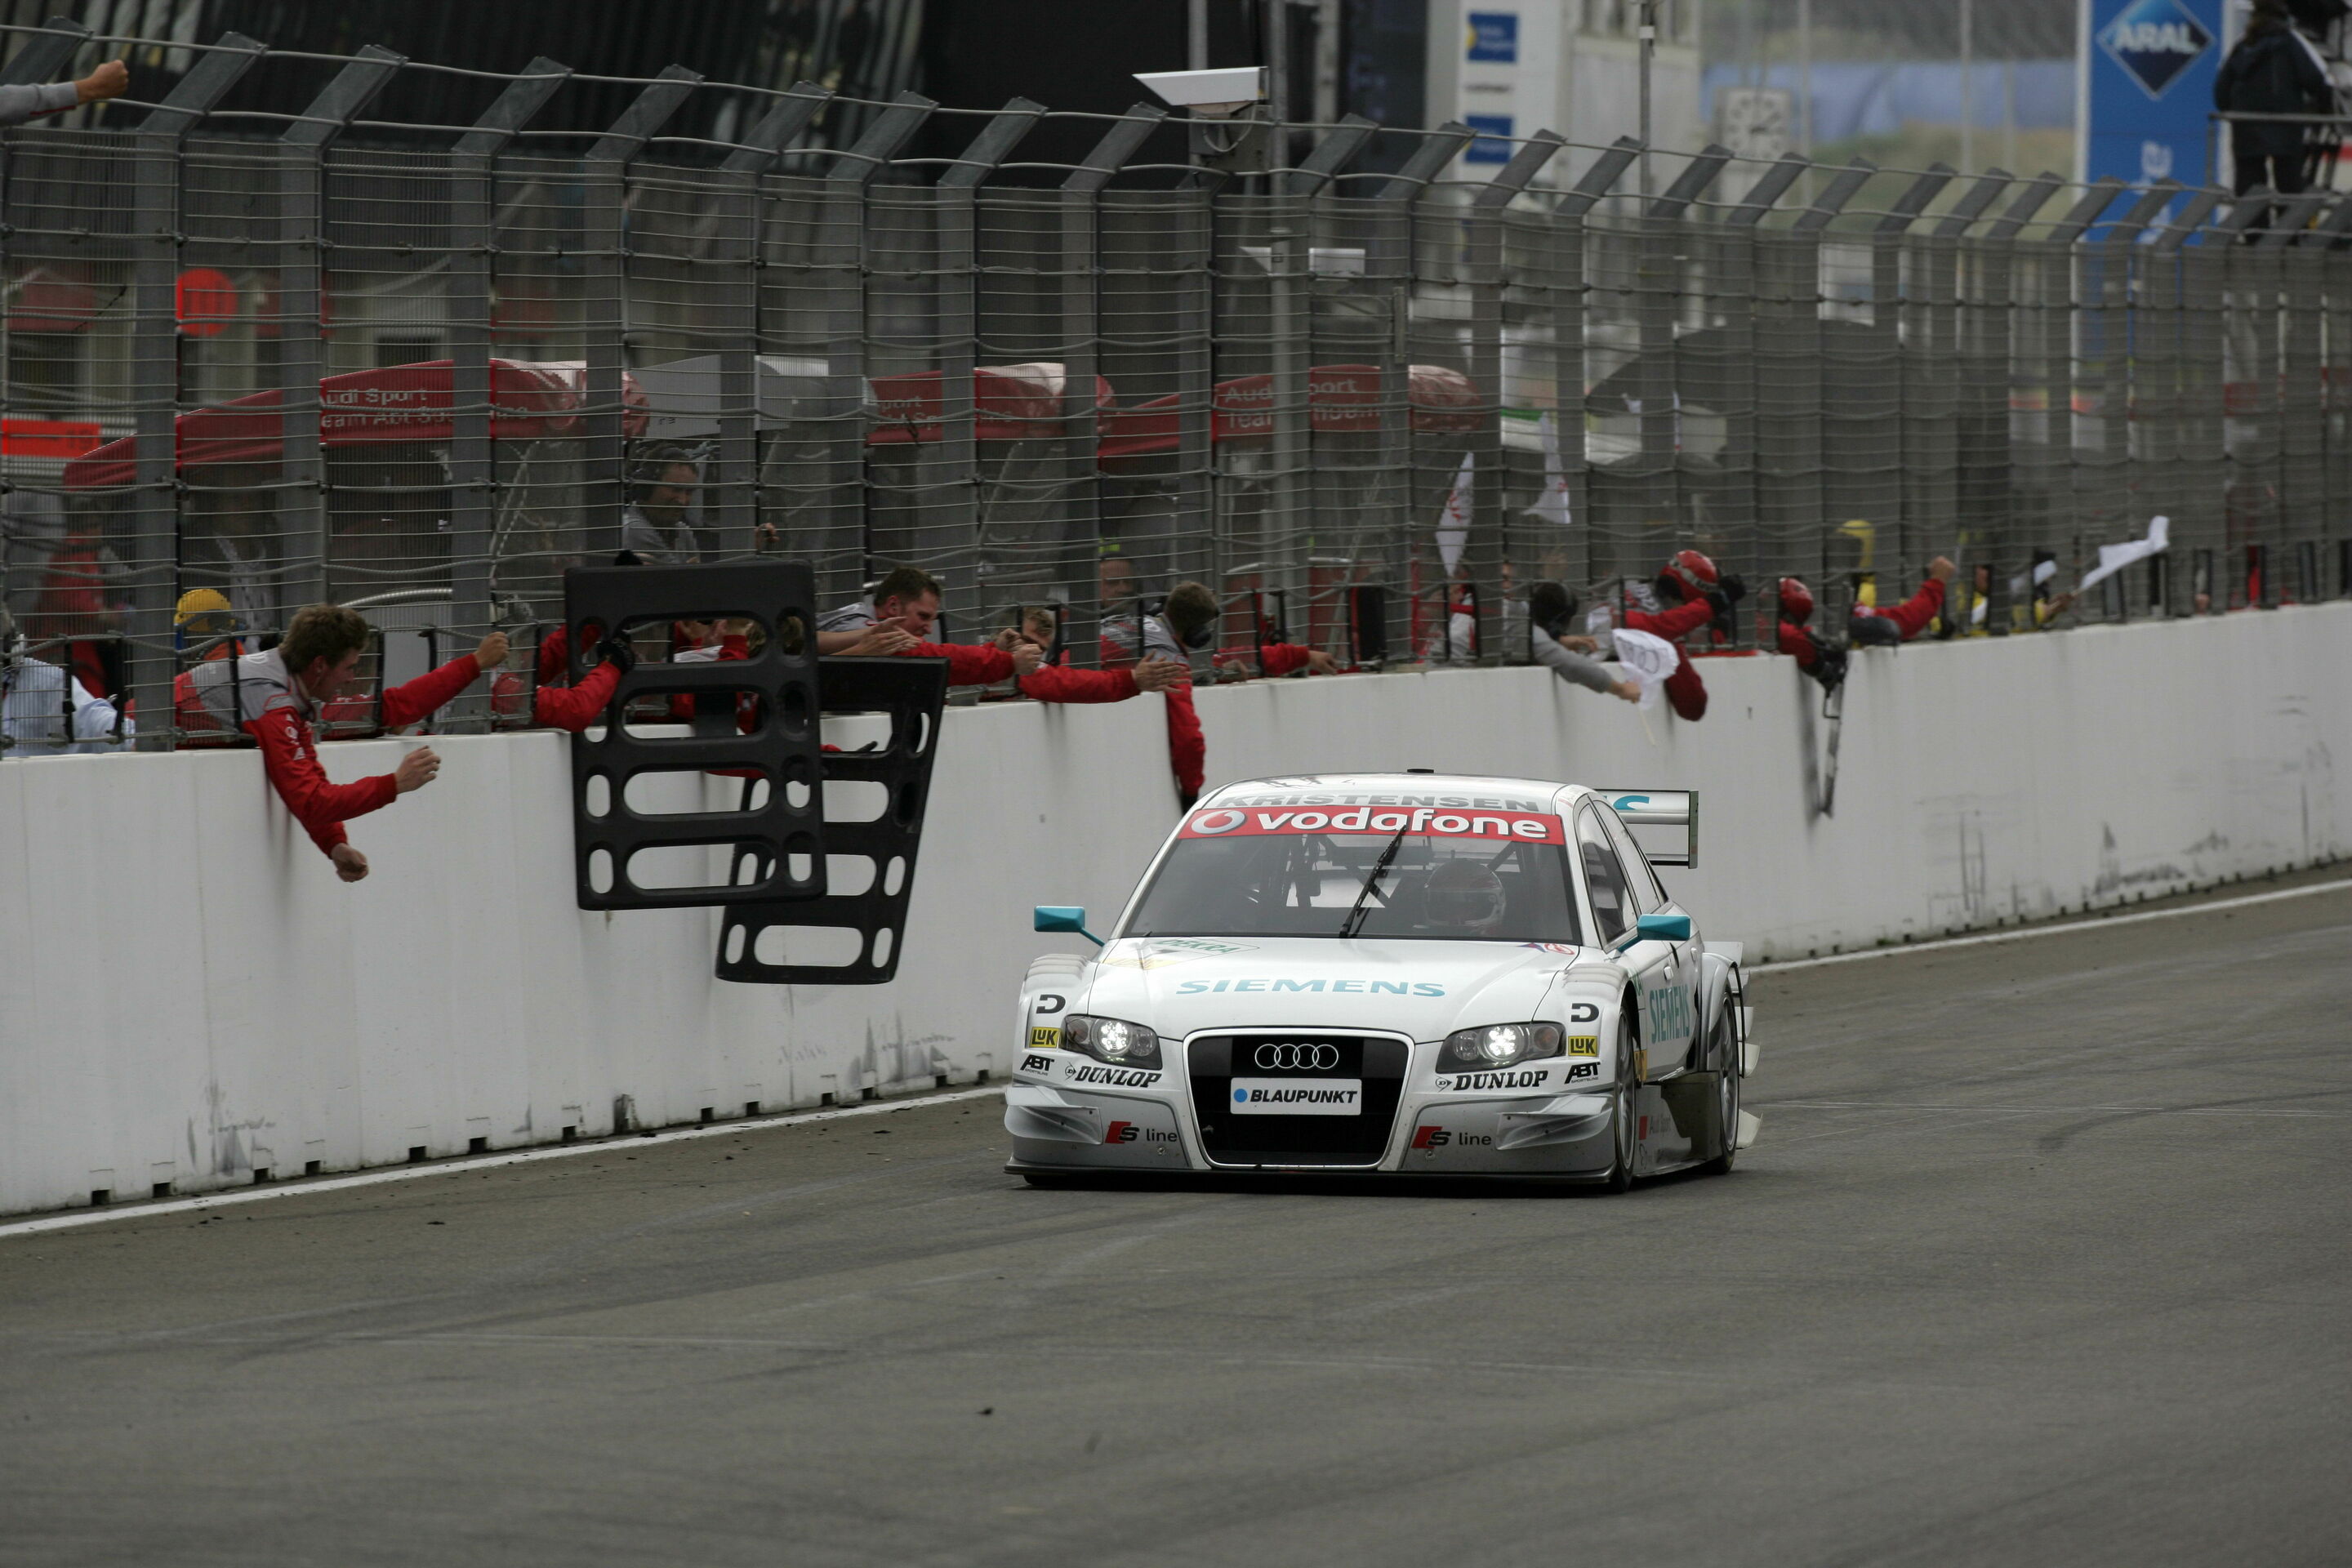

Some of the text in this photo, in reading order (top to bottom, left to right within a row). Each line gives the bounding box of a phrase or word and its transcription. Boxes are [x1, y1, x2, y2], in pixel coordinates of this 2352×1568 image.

[2114, 23, 2198, 54] ARAL
[1216, 795, 1539, 812] KRISTENSEN
[1258, 807, 1549, 840] vodafone
[1176, 979, 1446, 997] SIEMENS
[1649, 983, 1690, 1045] SIEMENS
[1020, 1054, 1055, 1071] ABT
[1075, 1066, 1162, 1088] DUNLOP
[1453, 1070, 1549, 1091] DUNLOP
[1564, 1062, 1601, 1085] ABT
[1250, 1089, 1357, 1103] BLAUPUNKT
[1146, 1129, 1178, 1143] line
[1459, 1132, 1492, 1146] line
